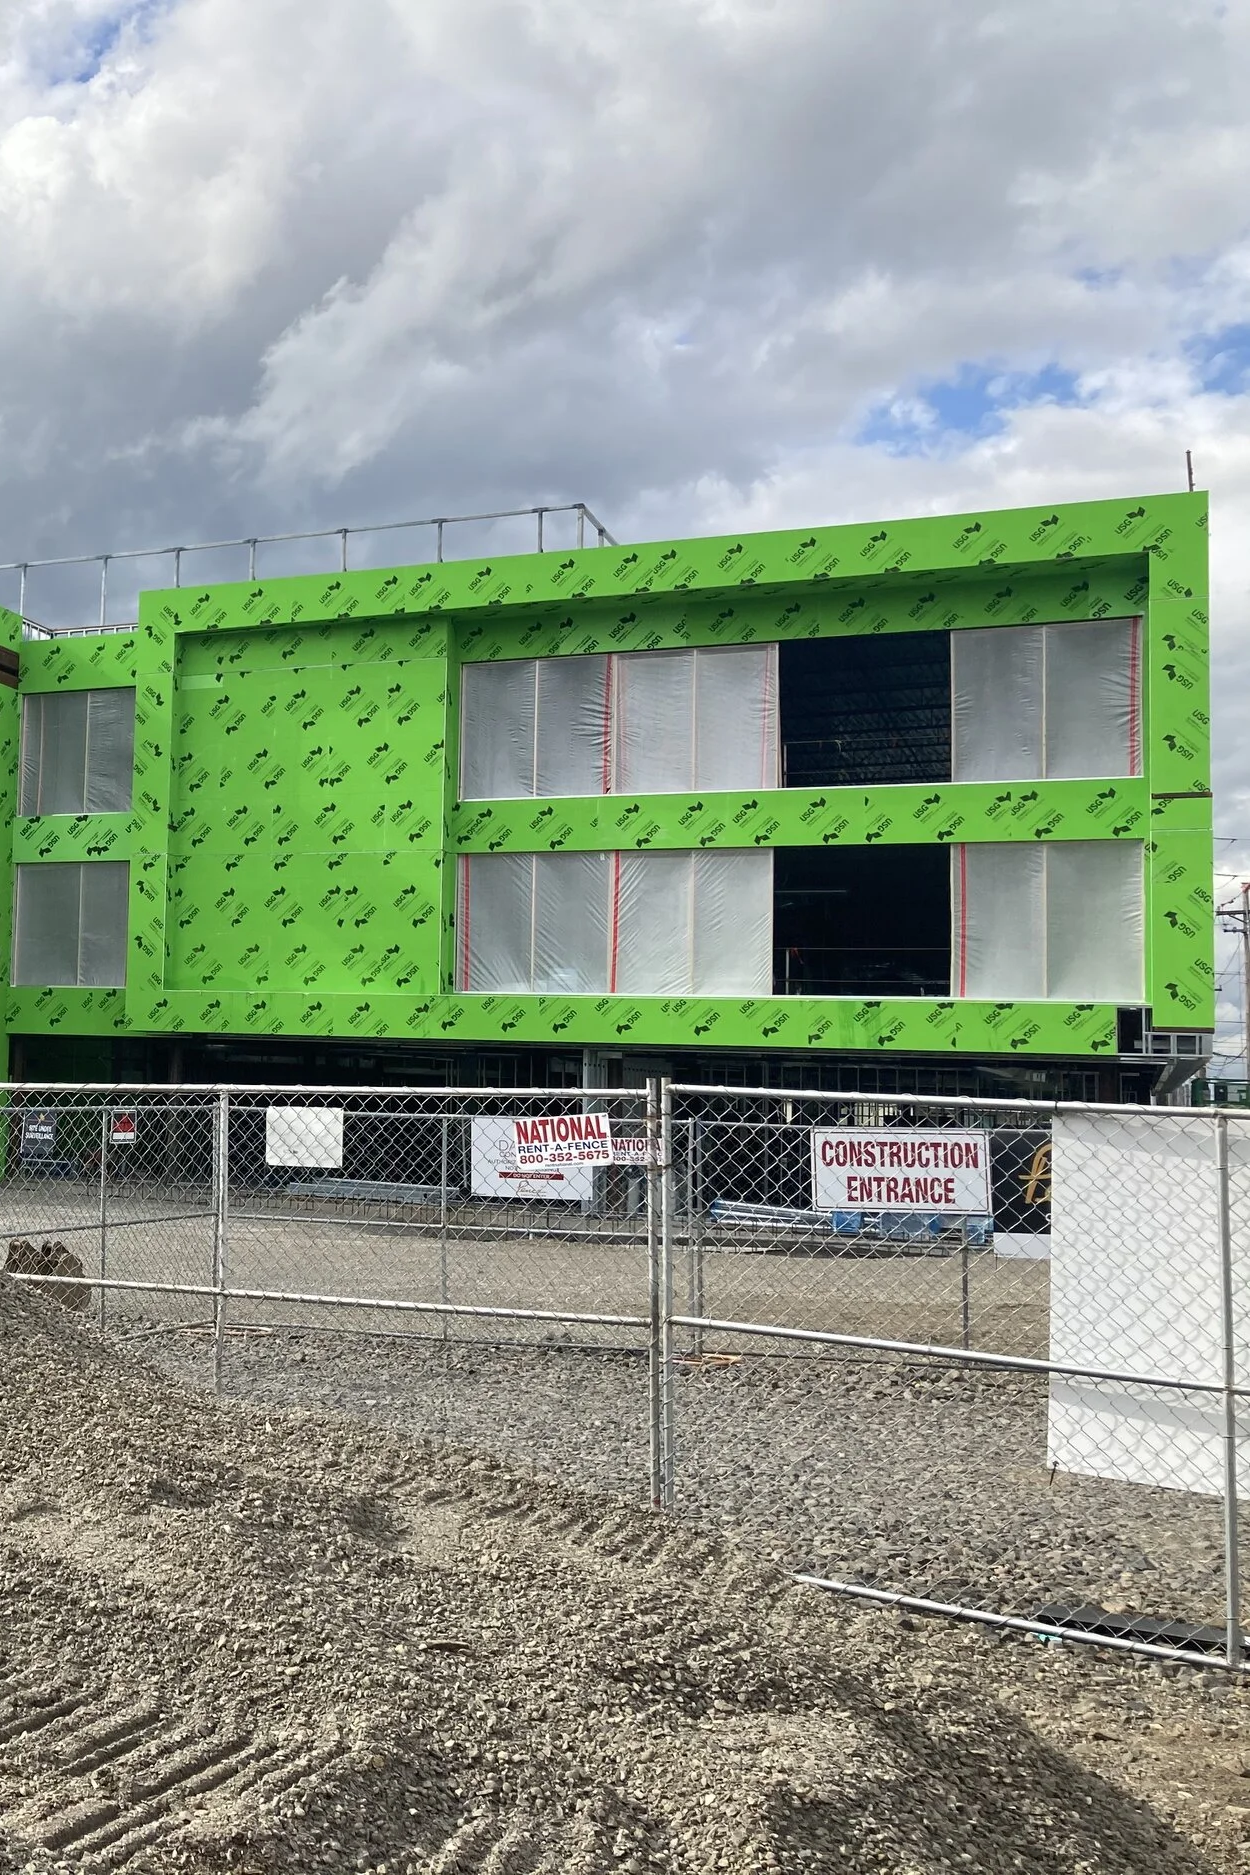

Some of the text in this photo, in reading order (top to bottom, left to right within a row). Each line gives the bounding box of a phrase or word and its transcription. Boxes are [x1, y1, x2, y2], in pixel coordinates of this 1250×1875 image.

[1115, 519, 1132, 537] USG
[1029, 527, 1046, 544] USG
[1155, 529, 1172, 544] USG
[860, 542, 875, 556] USG
[953, 534, 970, 552] USG
[1068, 534, 1085, 552] USG
[718, 555, 732, 568] USG
[824, 558, 840, 572] USG
[898, 552, 912, 567] USG
[613, 564, 628, 577] USG
[653, 560, 666, 574] USG
[750, 564, 766, 578] USG
[551, 570, 564, 583] USG
[684, 570, 699, 583] USG
[468, 578, 482, 590] USG
[581, 578, 595, 592] USG
[1167, 579, 1184, 594] USG
[242, 598, 254, 610] USG
[984, 599, 1001, 613] USG
[1060, 592, 1078, 610] USG
[190, 603, 201, 615] USG
[838, 608, 853, 622] USG
[944, 614, 959, 627] USG
[152, 630, 163, 646] USG
[518, 632, 532, 645] USG
[89, 651, 100, 663] USG
[115, 649, 126, 660] USG
[65, 664, 76, 674] USG
[1176, 674, 1194, 690] USG
[284, 699, 297, 711] USG
[339, 696, 351, 708] USG
[311, 708, 324, 721] USG
[367, 705, 380, 717] USG
[367, 752, 379, 765] USG
[1177, 745, 1194, 760] USG
[338, 765, 351, 777] USG
[395, 762, 408, 775] USG
[198, 771, 210, 783] USG
[221, 770, 232, 782] USG
[985, 802, 1001, 816] USG
[1086, 799, 1103, 813] USG
[371, 810, 383, 823] USG
[390, 810, 403, 822] USG
[615, 814, 629, 827] USG
[732, 810, 747, 823] USG
[799, 808, 815, 821] USG
[1047, 814, 1064, 828] USG
[1126, 811, 1143, 826] USG
[67, 822, 79, 835] USG
[342, 823, 355, 835] USG
[529, 816, 543, 829] USG
[834, 819, 849, 833] USG
[877, 818, 892, 832] USG
[949, 816, 964, 830] USG
[20, 824, 32, 836] USG
[498, 829, 512, 841] USG
[560, 827, 573, 840] USG
[646, 825, 660, 838] USG
[710, 823, 726, 836] USG
[48, 835, 60, 848] USG
[1168, 866, 1186, 881] USG
[144, 885, 155, 902] USG
[319, 895, 331, 907] USG
[393, 894, 406, 907] USG
[237, 907, 249, 919] USG
[142, 940, 153, 957] USG
[34, 996, 45, 1007] USG
[1179, 995, 1196, 1011] USG
[11, 1006, 21, 1017] USG
[451, 1008, 464, 1021] USG
[512, 1010, 526, 1022] USG
[705, 1012, 720, 1026] USG
[774, 1013, 789, 1027] USG
[890, 1022, 905, 1036] USG
[1023, 1024, 1041, 1038] USG
[516, 1116, 607, 1144] NATIONAL
[518, 1140, 608, 1154] RENT-A-FENCE
[520, 1150, 610, 1164] 800-352-5675
[821, 1140, 980, 1168] CONSTRUCTION
[846, 1176, 956, 1204] ENTRANCE
